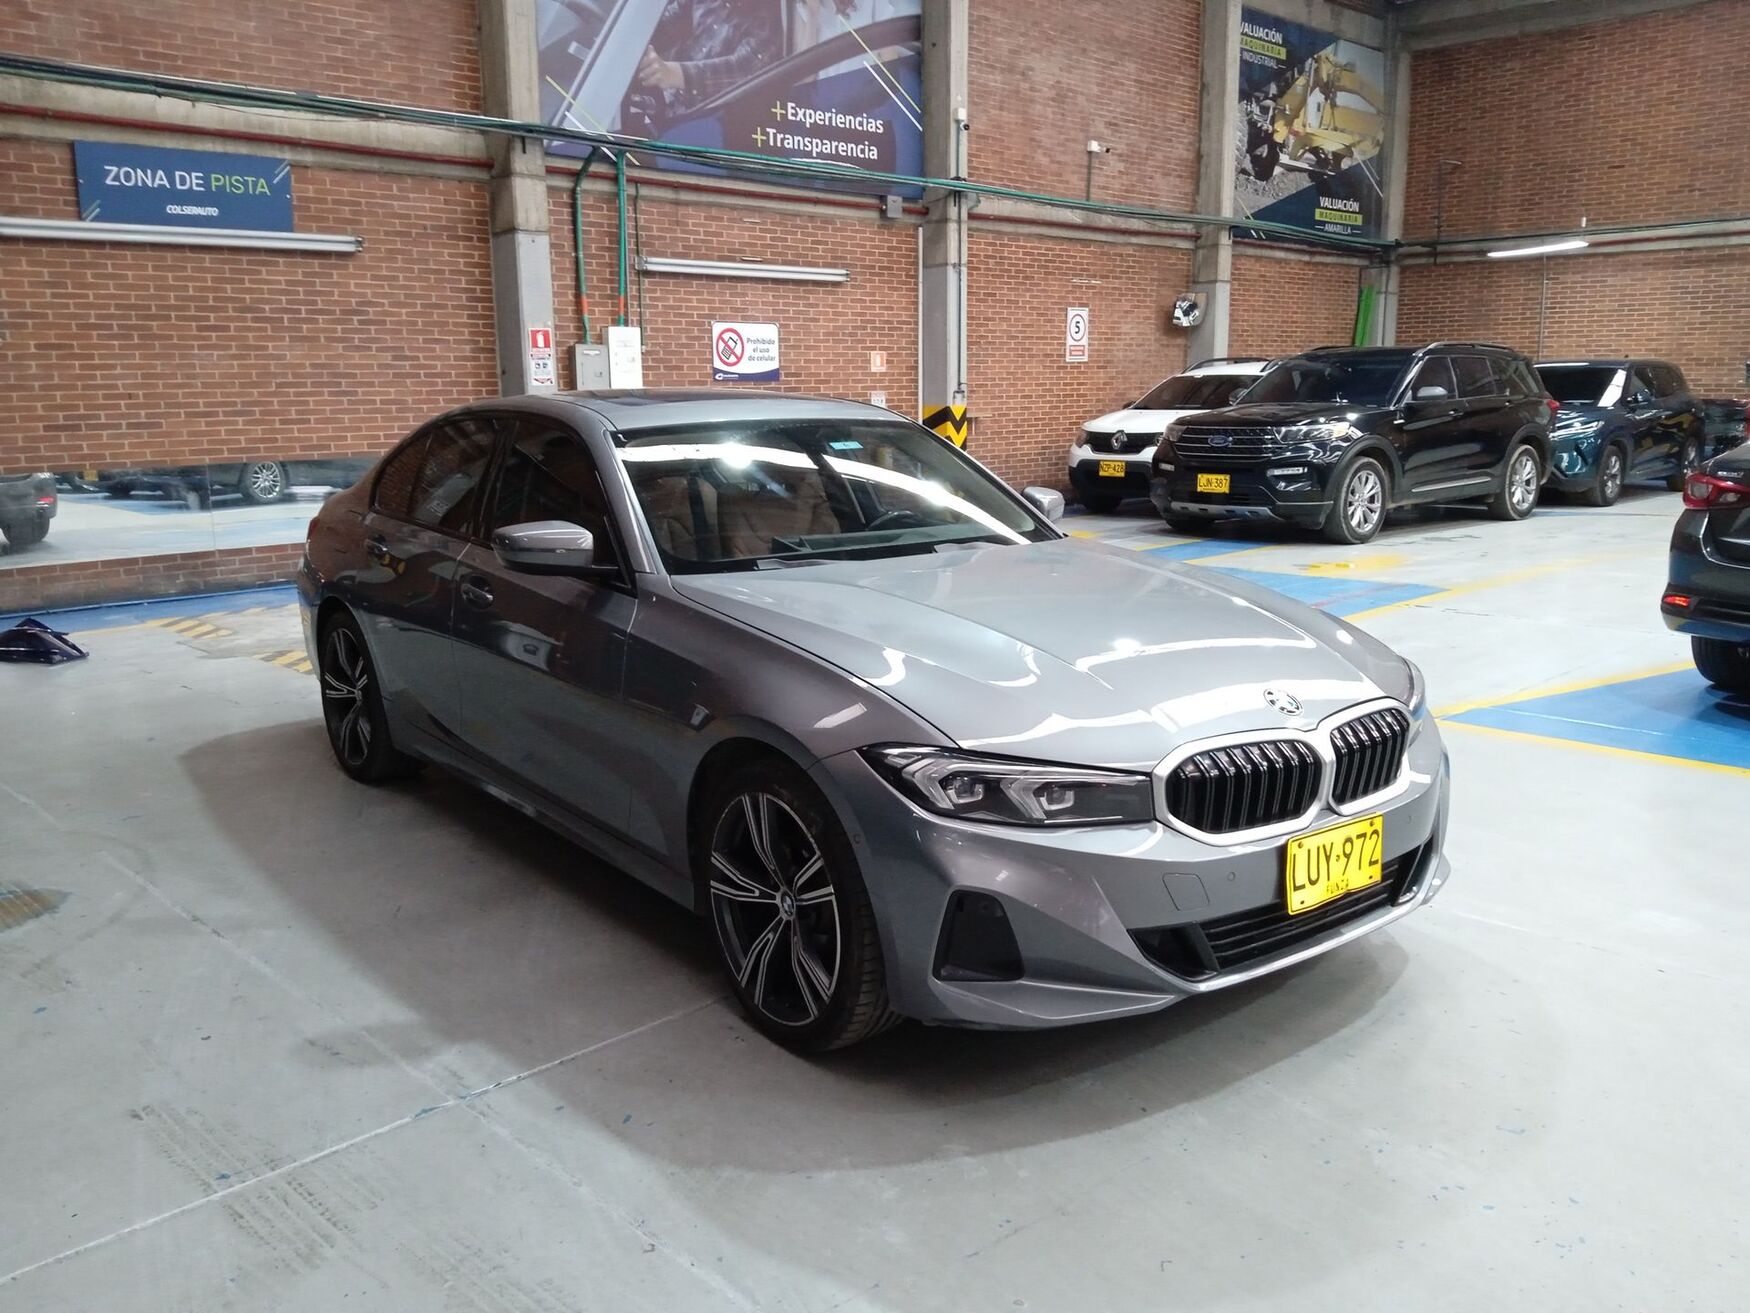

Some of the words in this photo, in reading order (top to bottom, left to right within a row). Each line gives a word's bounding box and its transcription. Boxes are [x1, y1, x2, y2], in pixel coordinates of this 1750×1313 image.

[104, 165, 171, 188] ZONA
[174, 171, 206, 192] DE
[210, 173, 272, 197] PISTA
[166, 204, 220, 217] COLSERAUTO
[1319, 196, 1360, 213] VALUACIÓN
[1319, 210, 1358, 223] MAQUINARIA
[1323, 223, 1352, 235] AMARILLA
[1074, 320, 1081, 335] 5
[746, 337, 776, 345] Prohibido
